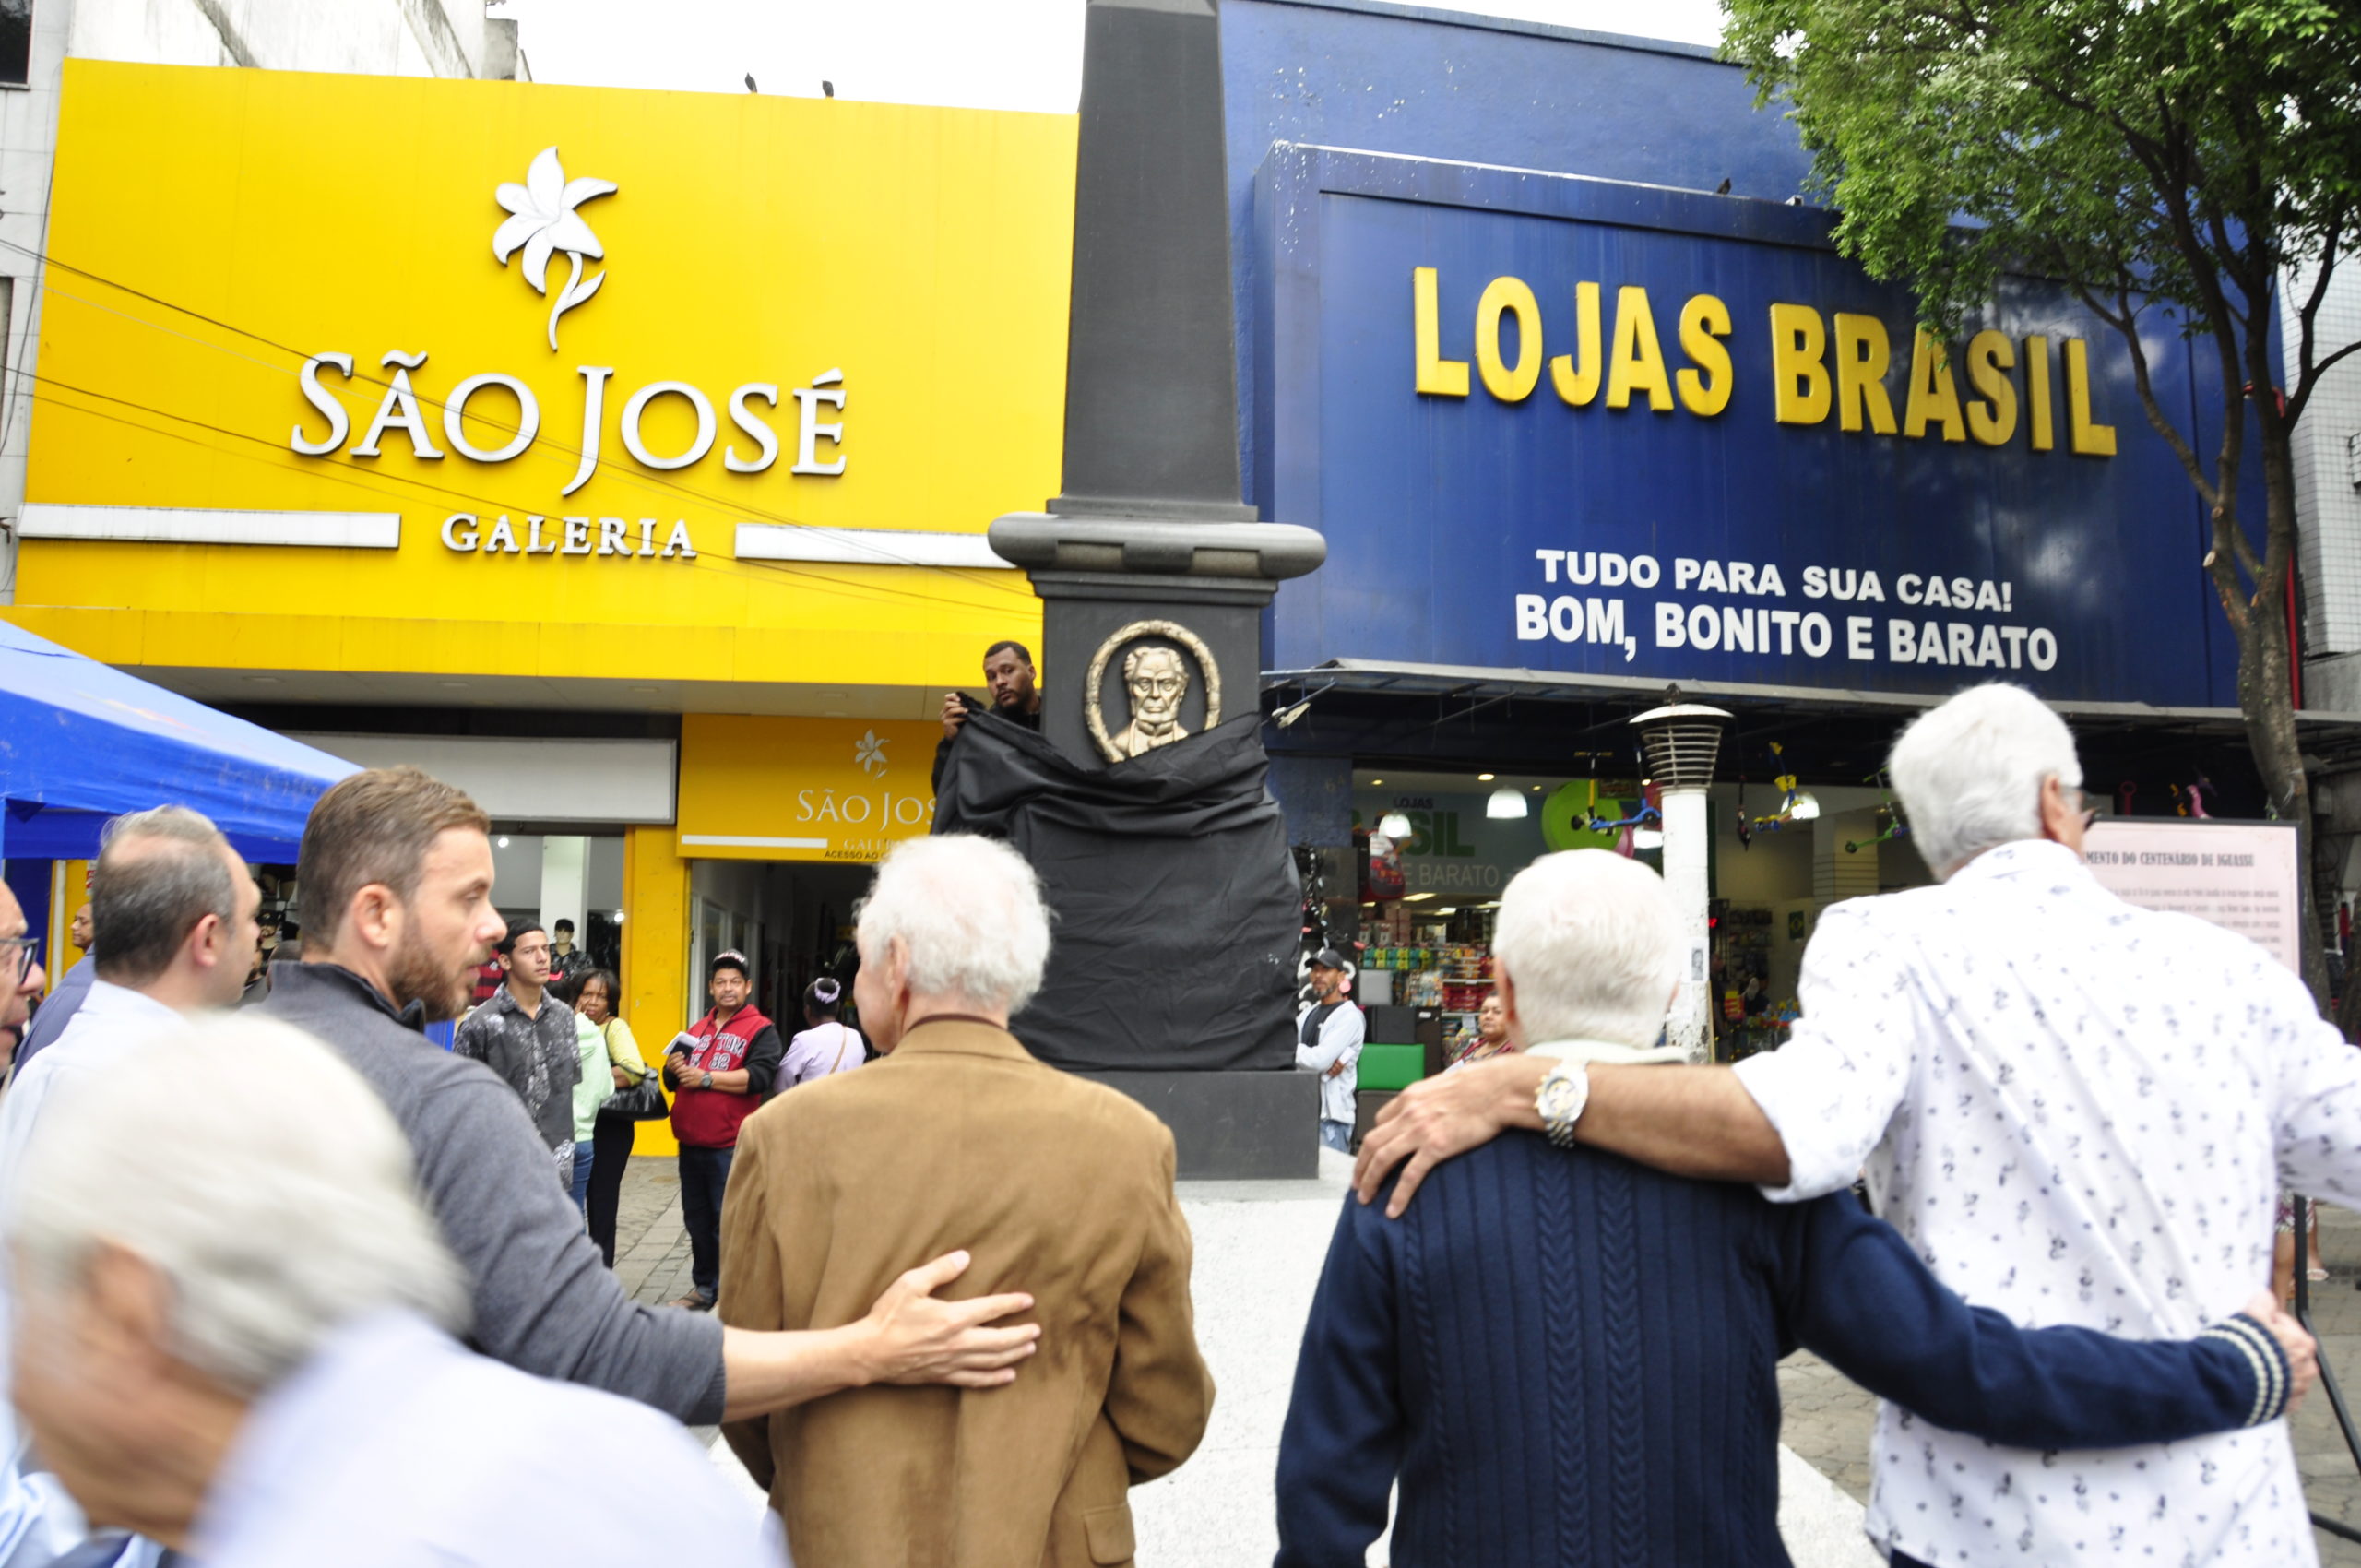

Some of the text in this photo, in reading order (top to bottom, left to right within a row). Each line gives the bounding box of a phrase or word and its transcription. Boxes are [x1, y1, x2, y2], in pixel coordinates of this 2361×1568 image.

[1413, 266, 2118, 457] LOJAS BRASIL
[290, 350, 848, 498] SÃO JOSÉ
[441, 513, 697, 559] GALERIA
[1536, 548, 2013, 612] TUDO PARA SUA CASA!
[1515, 593, 2058, 672] BOM, BONITO E BARATO
[796, 787, 871, 823] SÃO
[1394, 797, 1434, 810] LOJAS
[825, 849, 863, 859] ACESSO
[2082, 850, 2119, 865] MENTO
[2122, 851, 2137, 865] DO
[1418, 863, 1500, 887] BARATO
